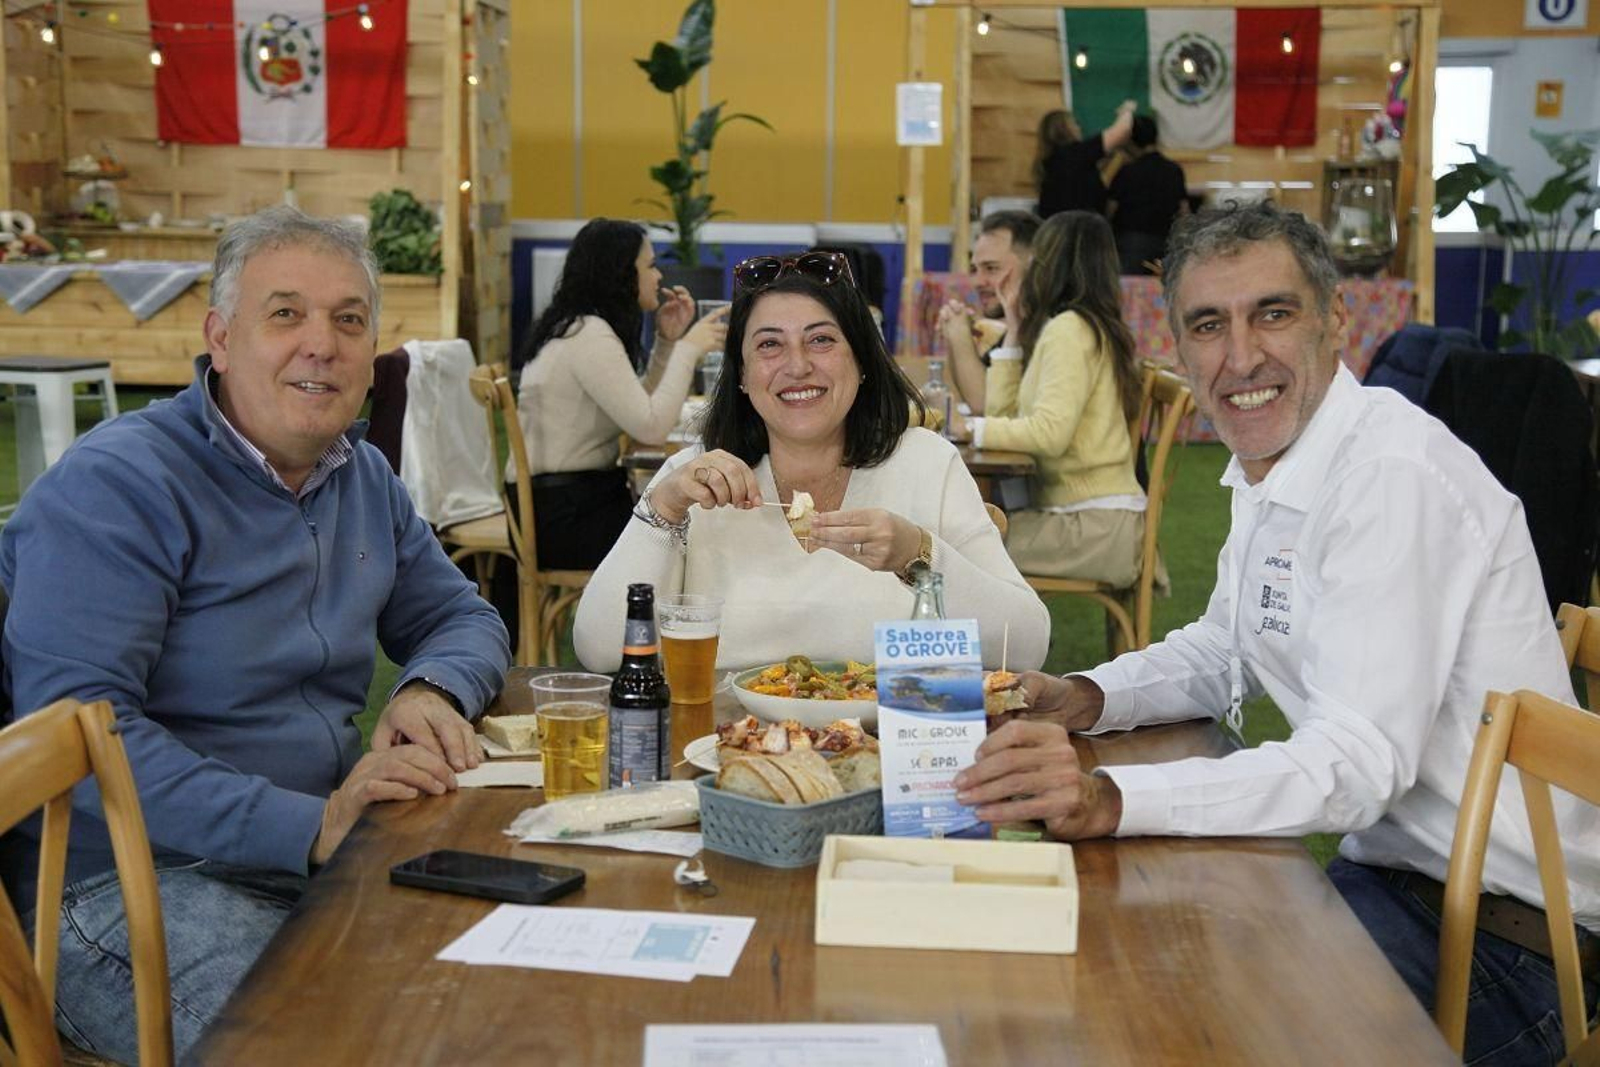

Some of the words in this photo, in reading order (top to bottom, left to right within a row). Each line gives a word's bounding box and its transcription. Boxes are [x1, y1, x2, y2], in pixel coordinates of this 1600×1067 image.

[886, 628, 966, 642] Saborea
[886, 644, 900, 657] O
[905, 642, 968, 656] GROVE
